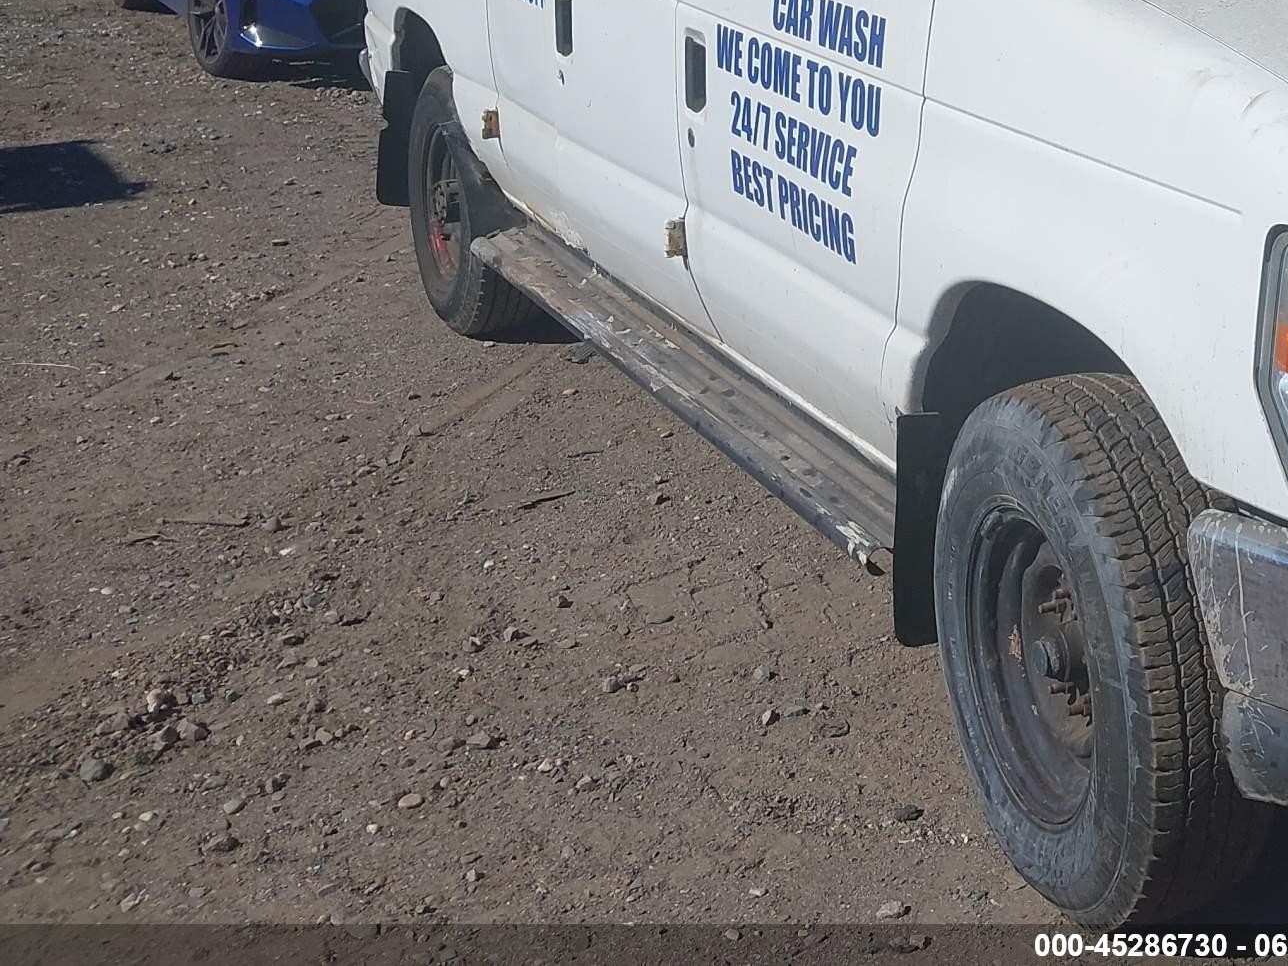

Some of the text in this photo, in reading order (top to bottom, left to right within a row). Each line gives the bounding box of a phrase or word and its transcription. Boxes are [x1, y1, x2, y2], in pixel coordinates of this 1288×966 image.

[716, 23, 882, 137] WE COME TO YOU
[730, 91, 858, 198] 24/7 SERVICE
[730, 149, 857, 265] BEST PRICING
